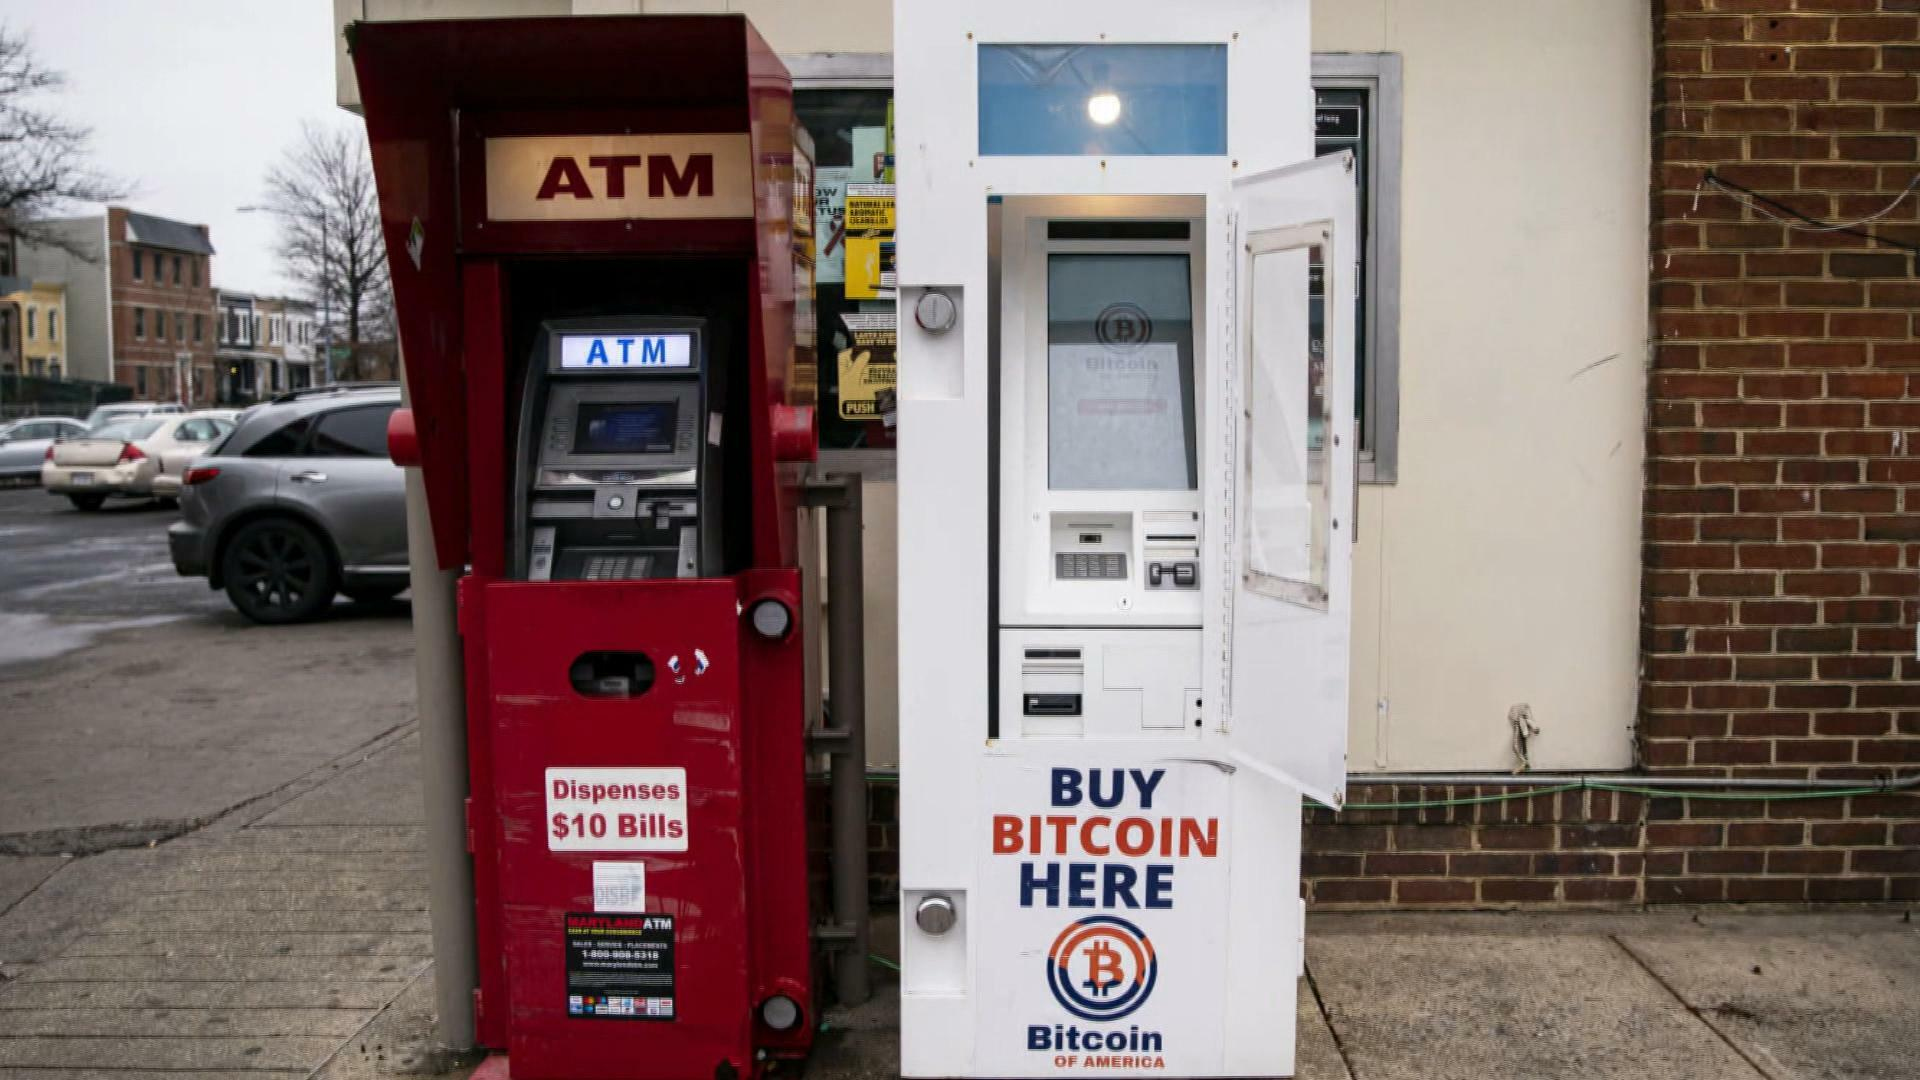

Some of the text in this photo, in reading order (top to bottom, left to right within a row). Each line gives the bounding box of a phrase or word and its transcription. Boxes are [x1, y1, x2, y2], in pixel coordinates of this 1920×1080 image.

[536, 154, 714, 200] ATM
[586, 337, 667, 366] ATM
[846, 402, 875, 414] PUSH
[552, 778, 681, 805] Dispenses
[1050, 767, 1166, 809] BUY
[552, 812, 684, 841] $10 Bills
[992, 815, 1219, 857] BITCOIN
[1020, 862, 1175, 910] HERE
[1028, 1024, 1163, 1052] Bitcoin
[1054, 1055, 1166, 1069] OF AMERICA
